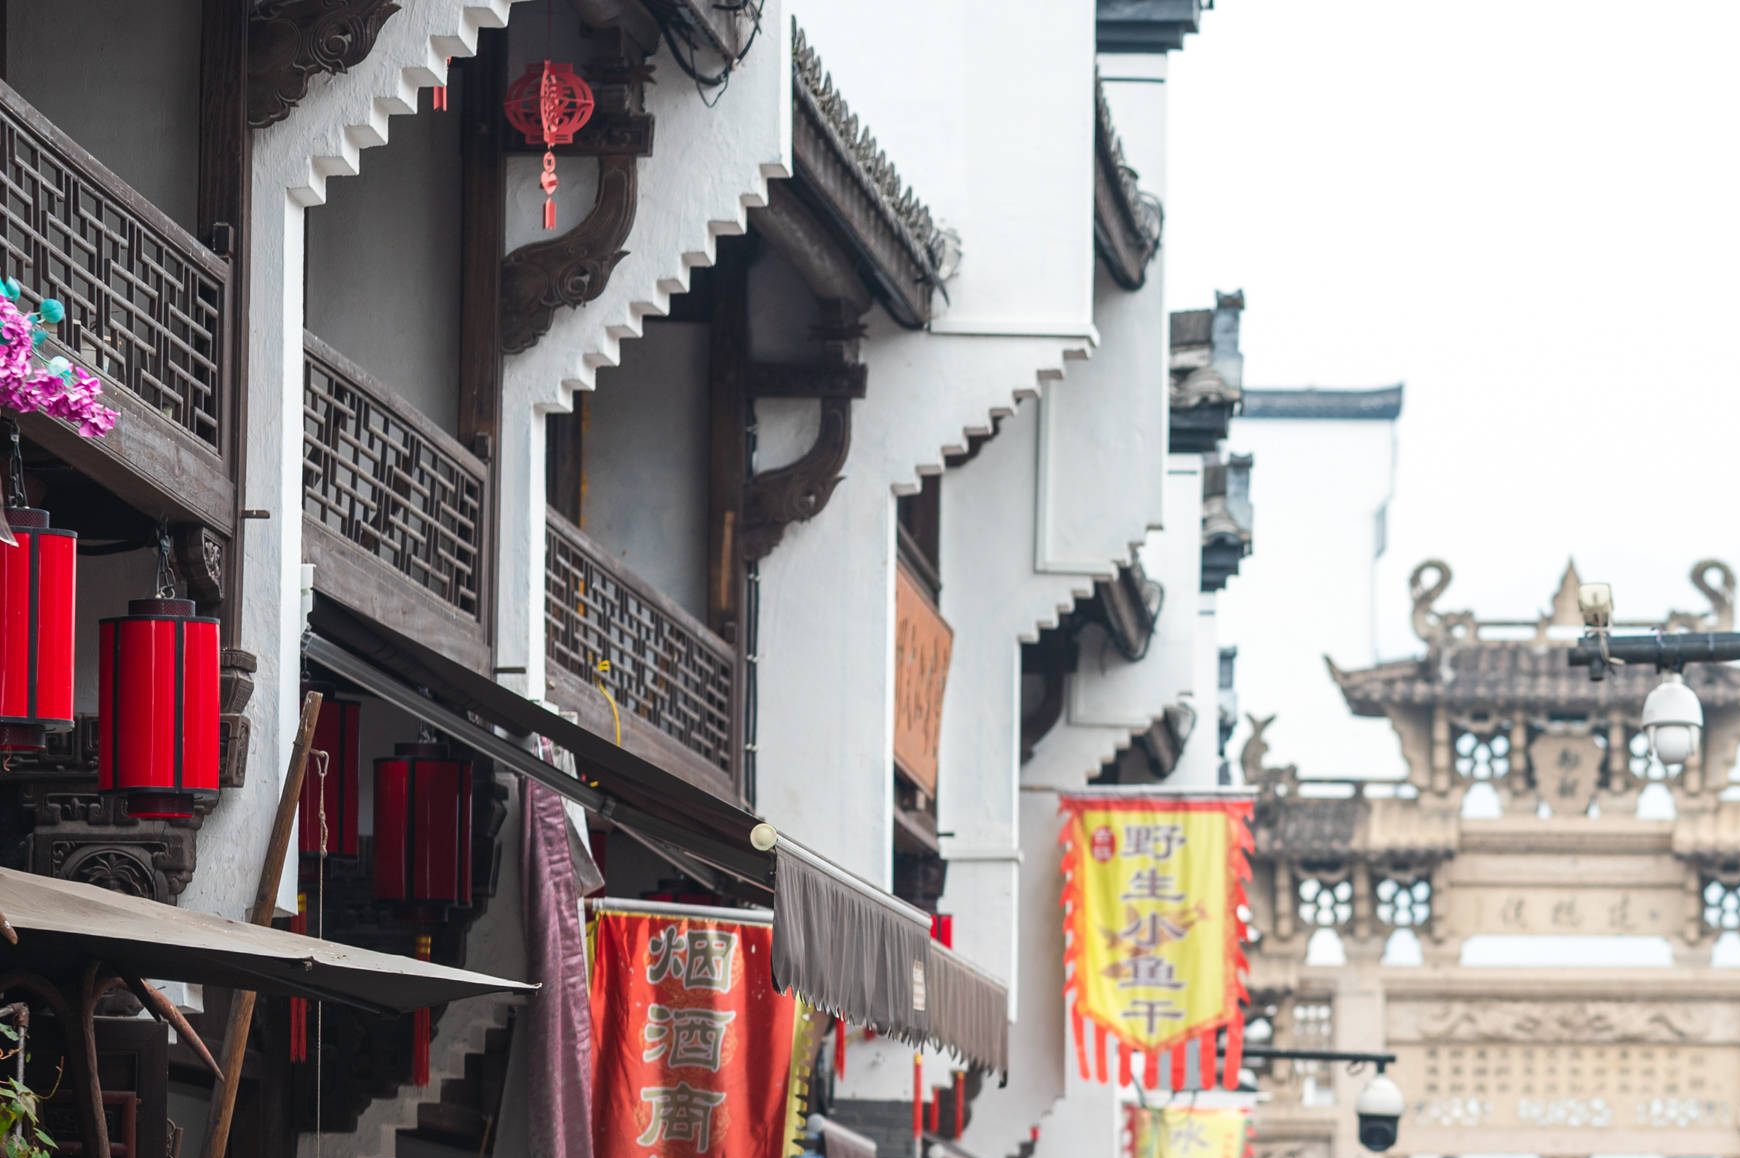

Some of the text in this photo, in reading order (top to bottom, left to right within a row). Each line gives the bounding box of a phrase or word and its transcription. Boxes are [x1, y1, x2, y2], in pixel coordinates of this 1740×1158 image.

[1118, 824, 1186, 1036] 野生小鱼干
